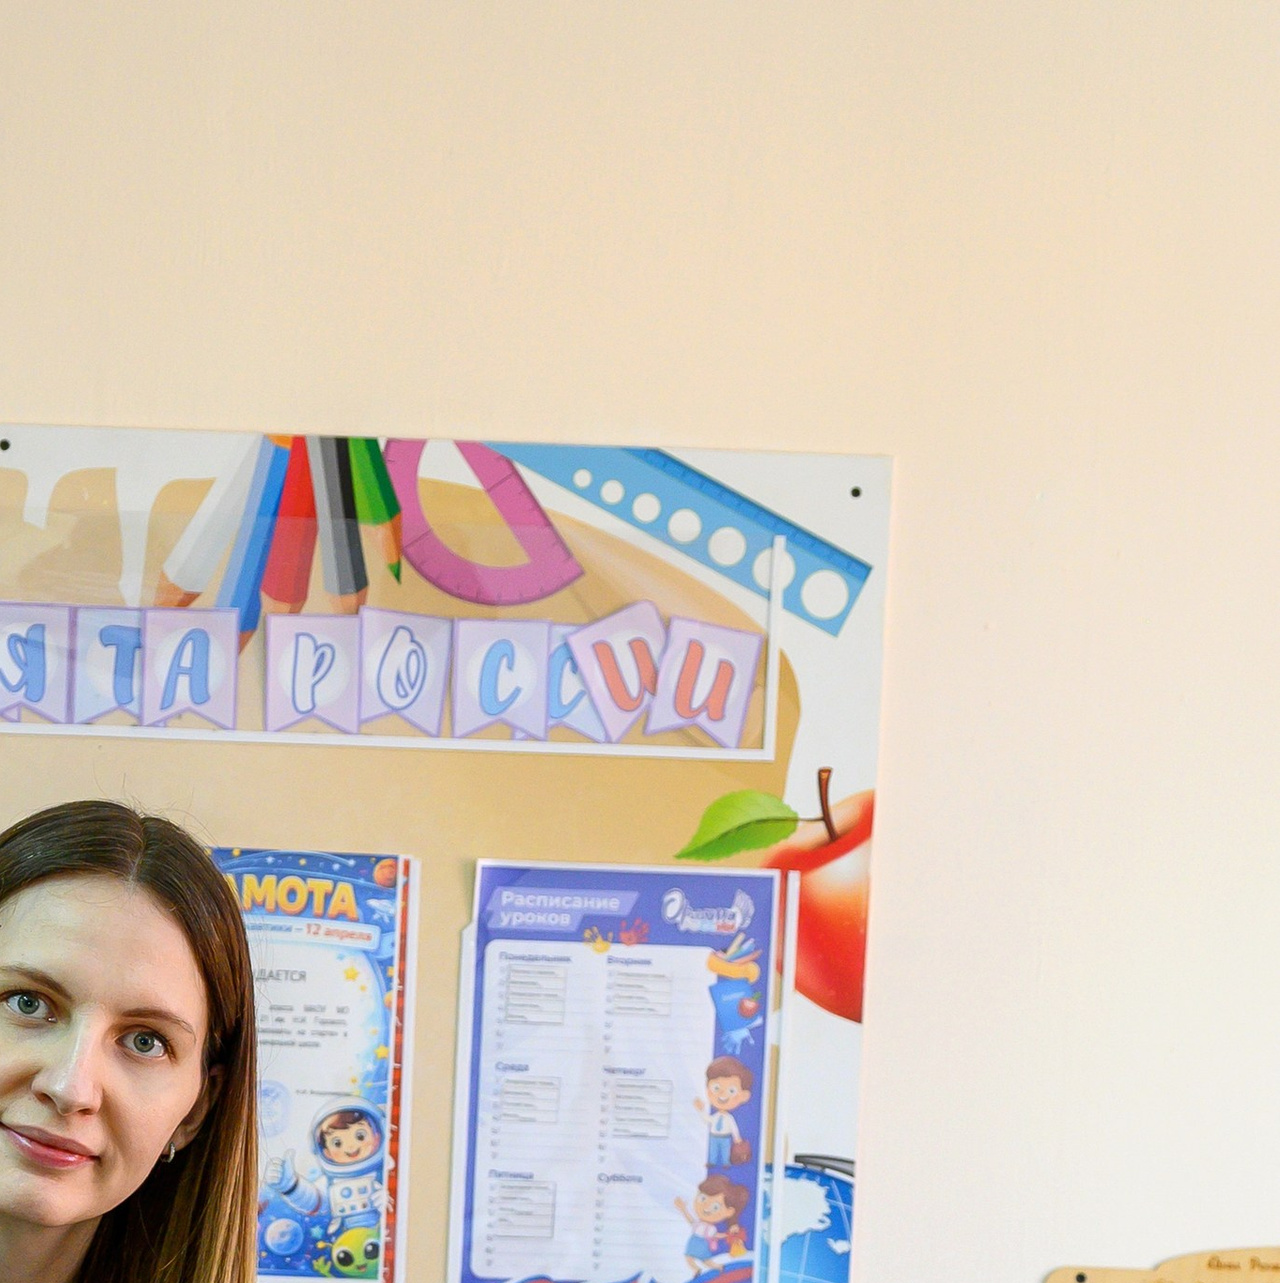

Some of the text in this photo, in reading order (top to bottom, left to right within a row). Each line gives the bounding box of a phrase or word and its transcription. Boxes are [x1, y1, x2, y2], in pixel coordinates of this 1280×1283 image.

[500, 890, 621, 911] Расписание
[499, 911, 570, 927] уроков
[306, 923, 322, 935] 12
[324, 926, 373, 942] апреля
[254, 968, 307, 982] ДАЕТСЯ
[598, 1172, 643, 1185] Суббота
